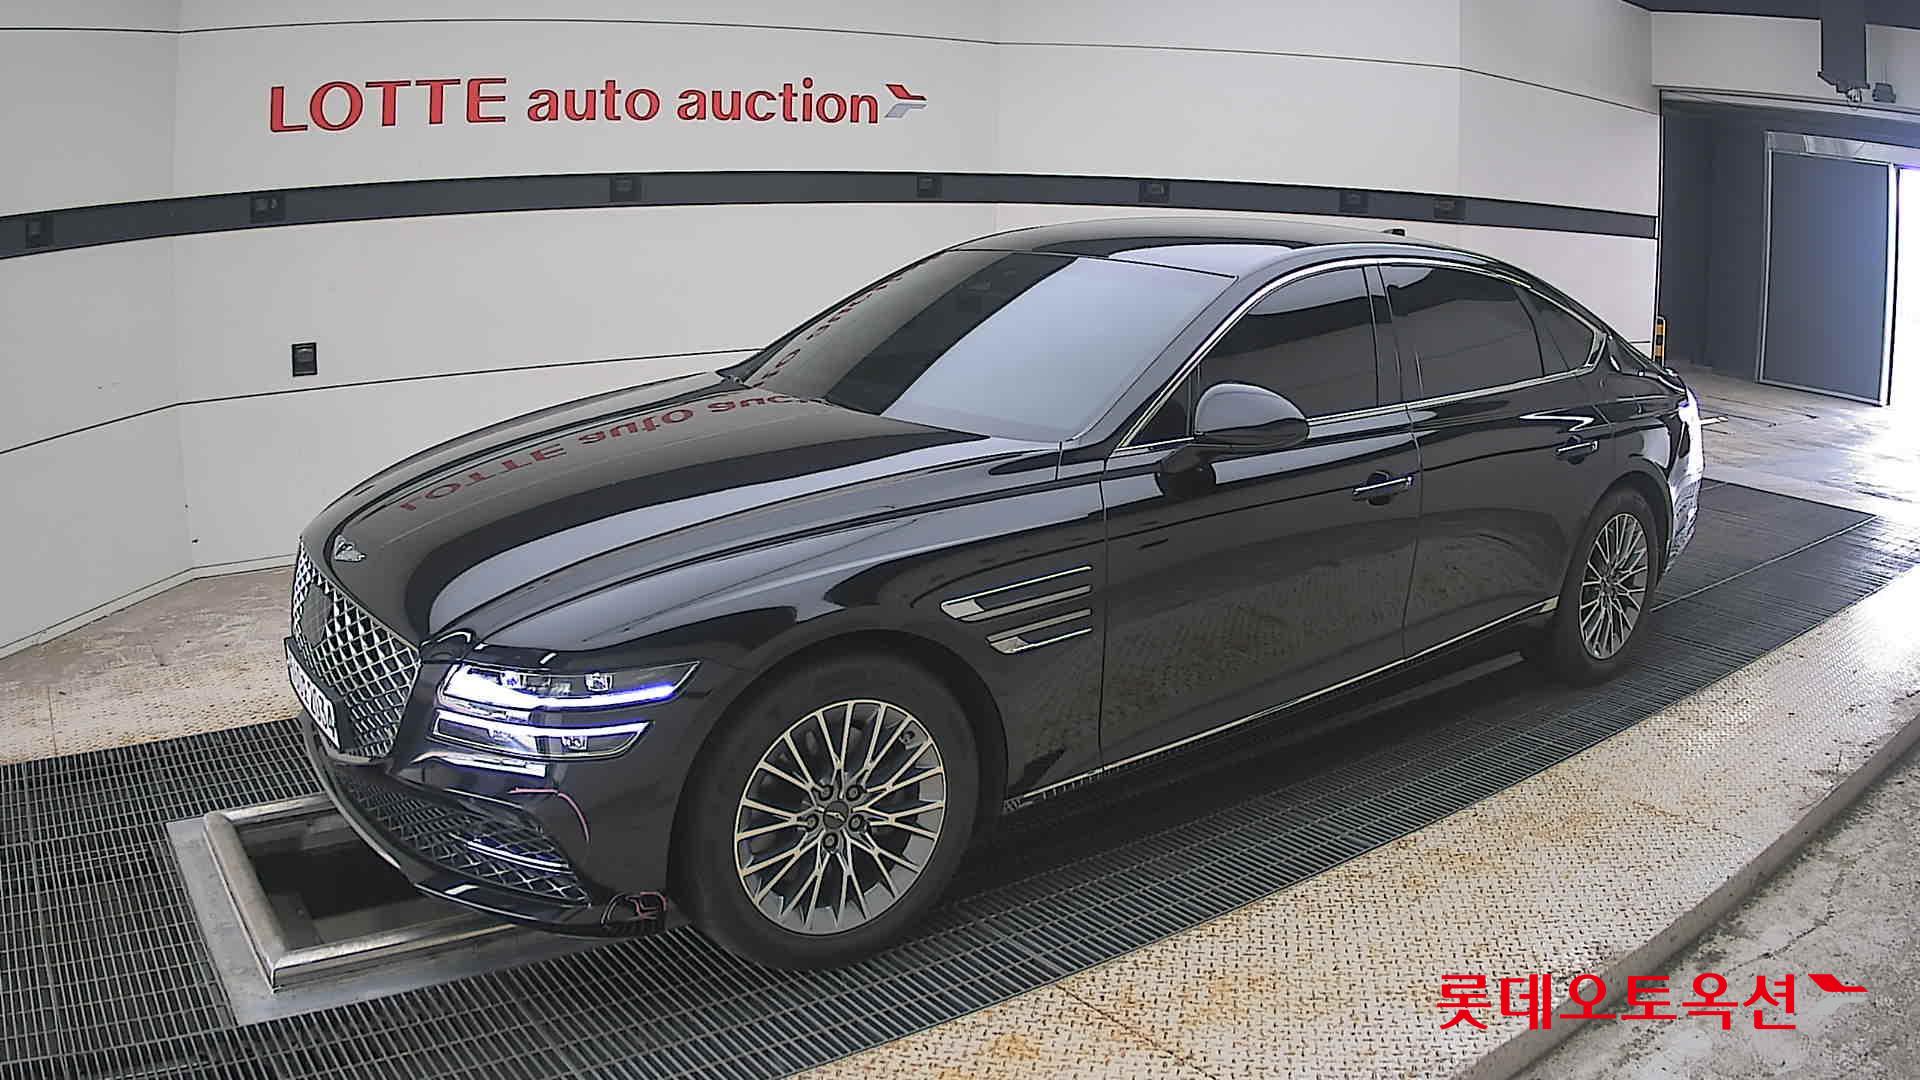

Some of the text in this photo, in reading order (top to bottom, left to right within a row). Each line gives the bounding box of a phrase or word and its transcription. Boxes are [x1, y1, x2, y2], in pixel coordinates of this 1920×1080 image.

[270, 77, 879, 133] LOTTE auto auction
